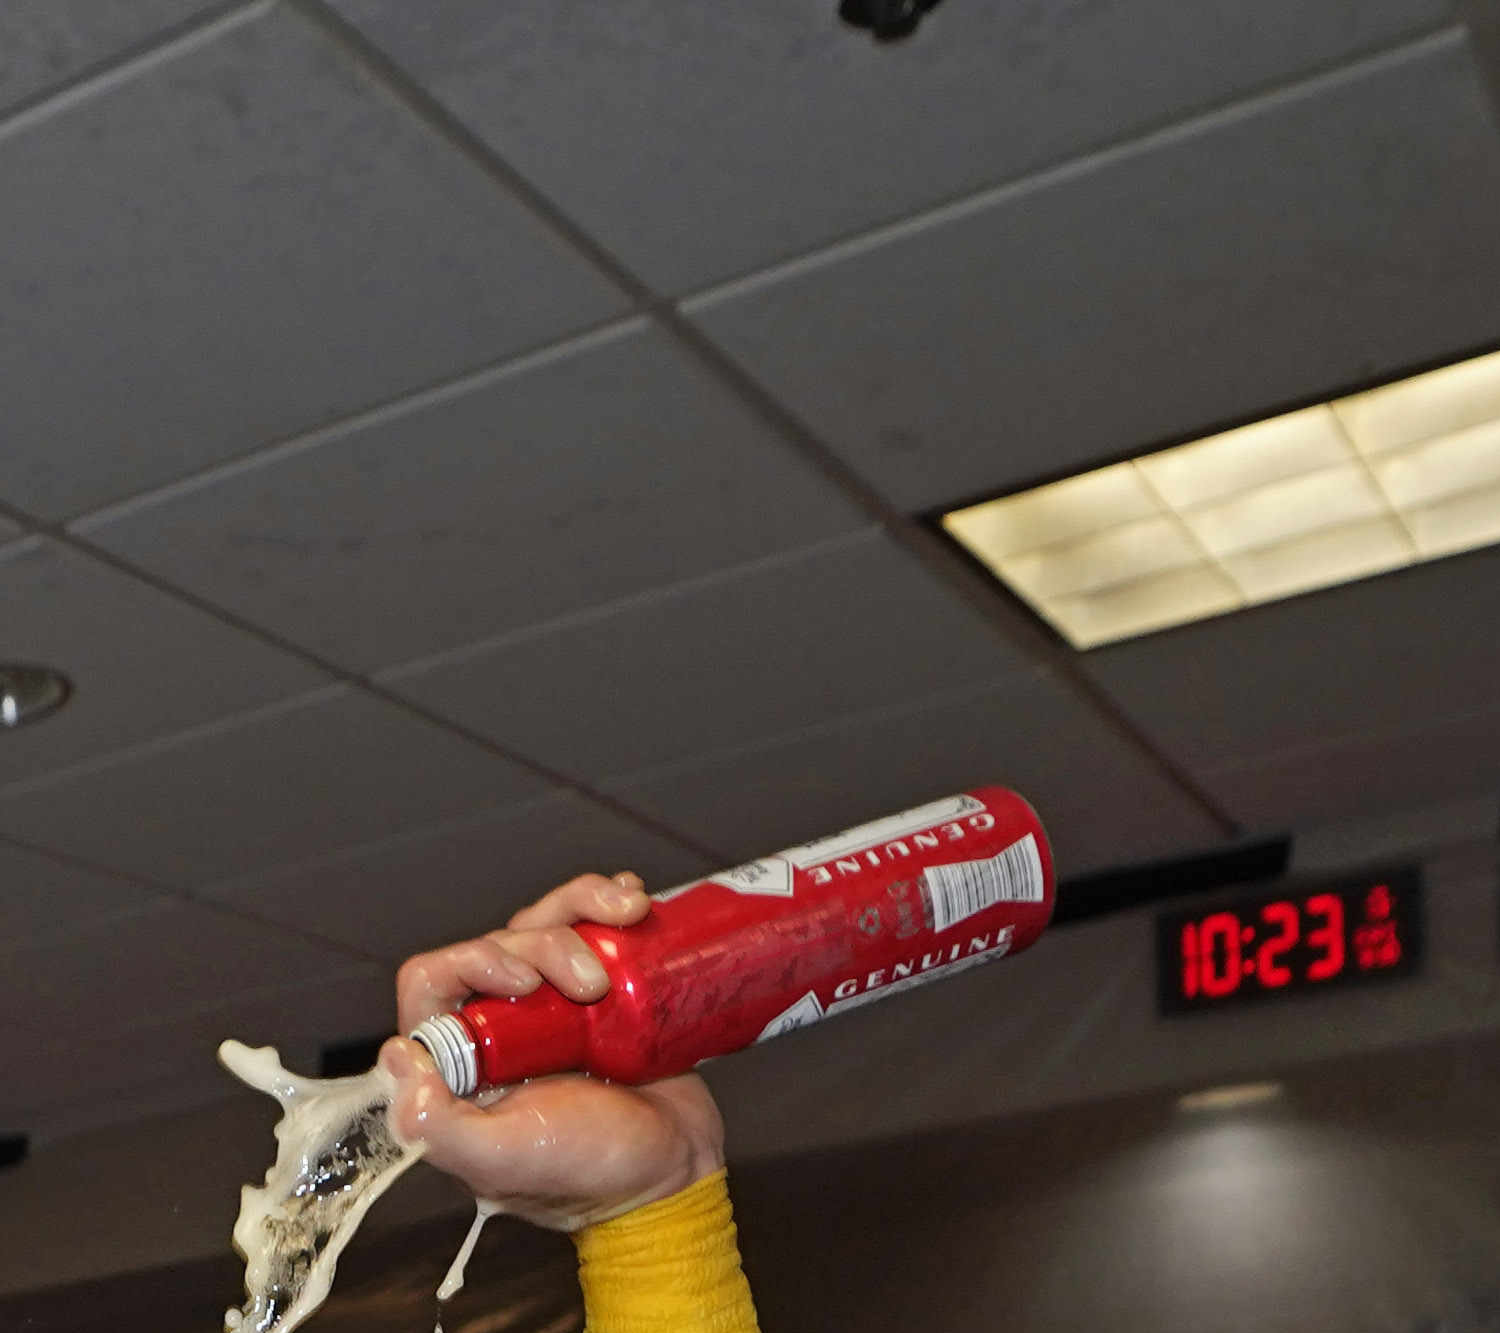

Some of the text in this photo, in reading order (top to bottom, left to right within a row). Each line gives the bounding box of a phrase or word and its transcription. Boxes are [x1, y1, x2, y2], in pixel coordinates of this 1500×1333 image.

[807, 812, 996, 886] GENUINE
[833, 924, 1017, 1000] GENUINE
[1182, 892, 1345, 1000] 10:23
